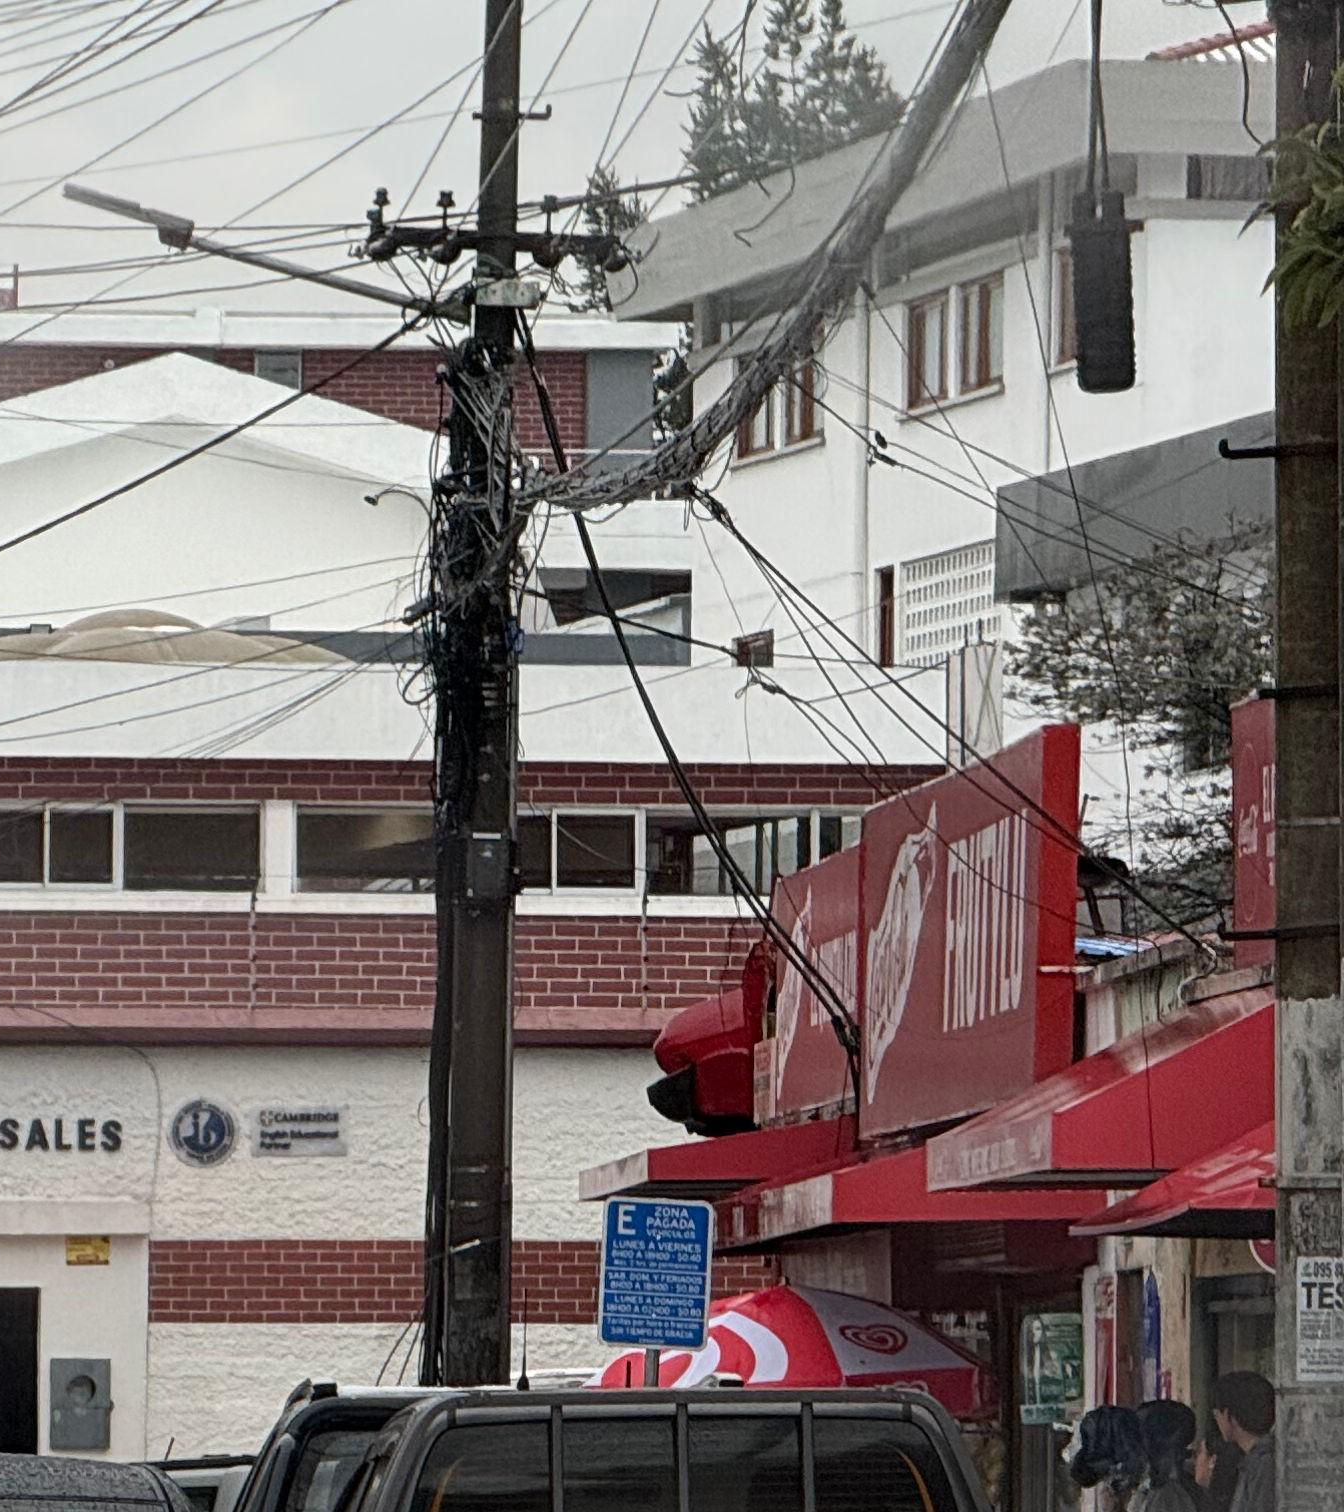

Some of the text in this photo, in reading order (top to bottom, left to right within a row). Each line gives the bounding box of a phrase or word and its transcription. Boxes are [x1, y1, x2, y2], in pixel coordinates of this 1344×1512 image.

[274, 1112, 339, 1123] CAMBRIDGE
[654, 1206, 689, 1219] ZONA
[617, 1204, 637, 1236] E
[646, 1216, 696, 1230] PAGADA
[612, 1240, 702, 1253] LUNES A VIERNES
[1313, 1261, 1332, 1279] 095
[614, 1295, 644, 1304] LUNES
[653, 1297, 694, 1307] DOMINGO
